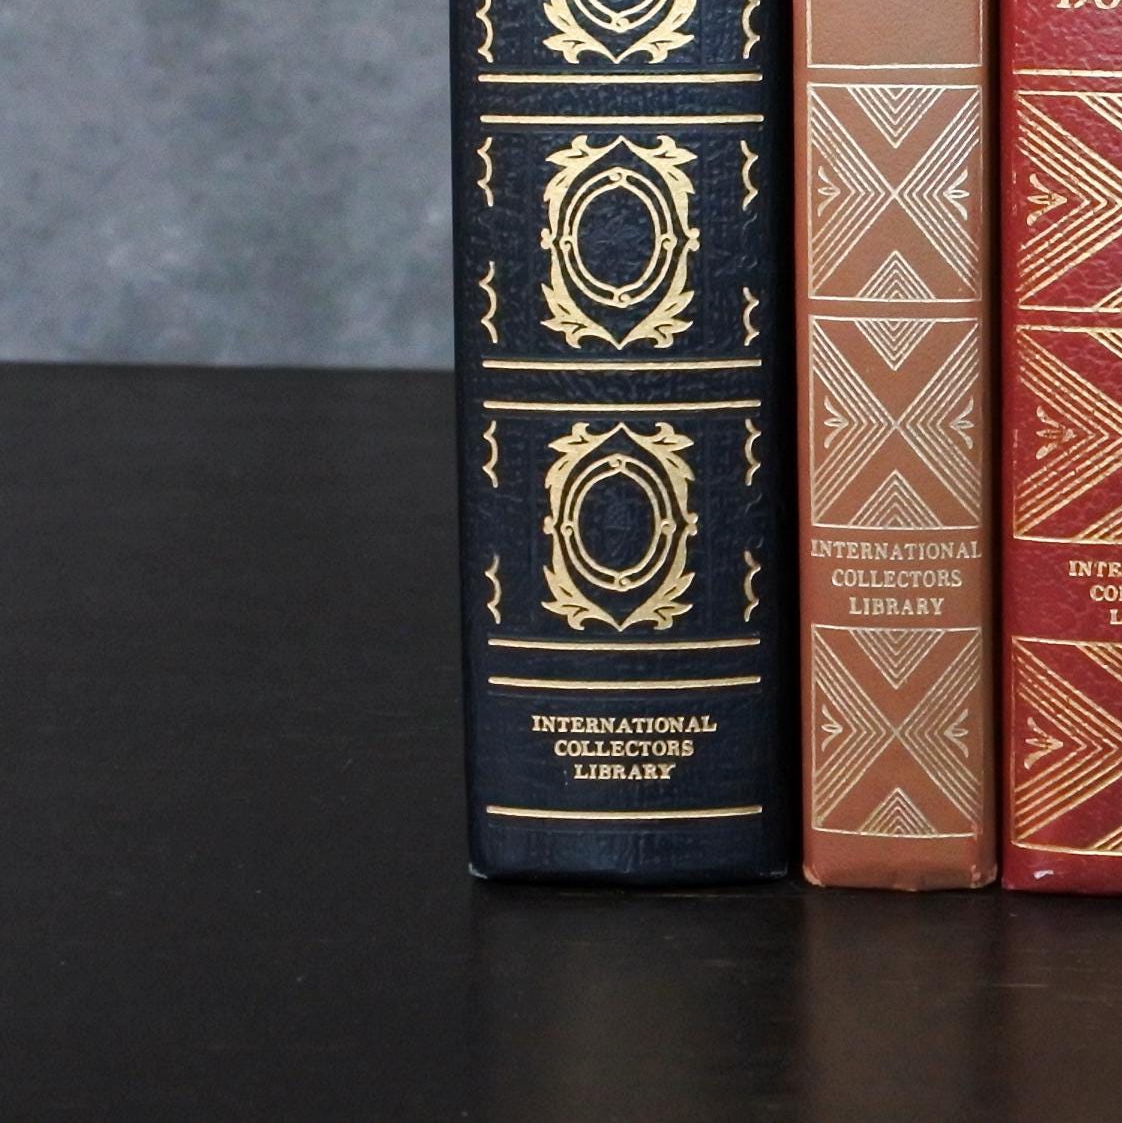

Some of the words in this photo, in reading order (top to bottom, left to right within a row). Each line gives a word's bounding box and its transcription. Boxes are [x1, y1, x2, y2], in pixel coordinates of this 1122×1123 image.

[811, 539, 982, 561] INTERNATIONAL
[831, 569, 963, 589] COLLECTORS
[849, 597, 945, 617] LIBRARY
[531, 715, 717, 734] INTERNATIONAL
[554, 739, 694, 758] COLLECTORS
[573, 763, 676, 781] LIBRARY
